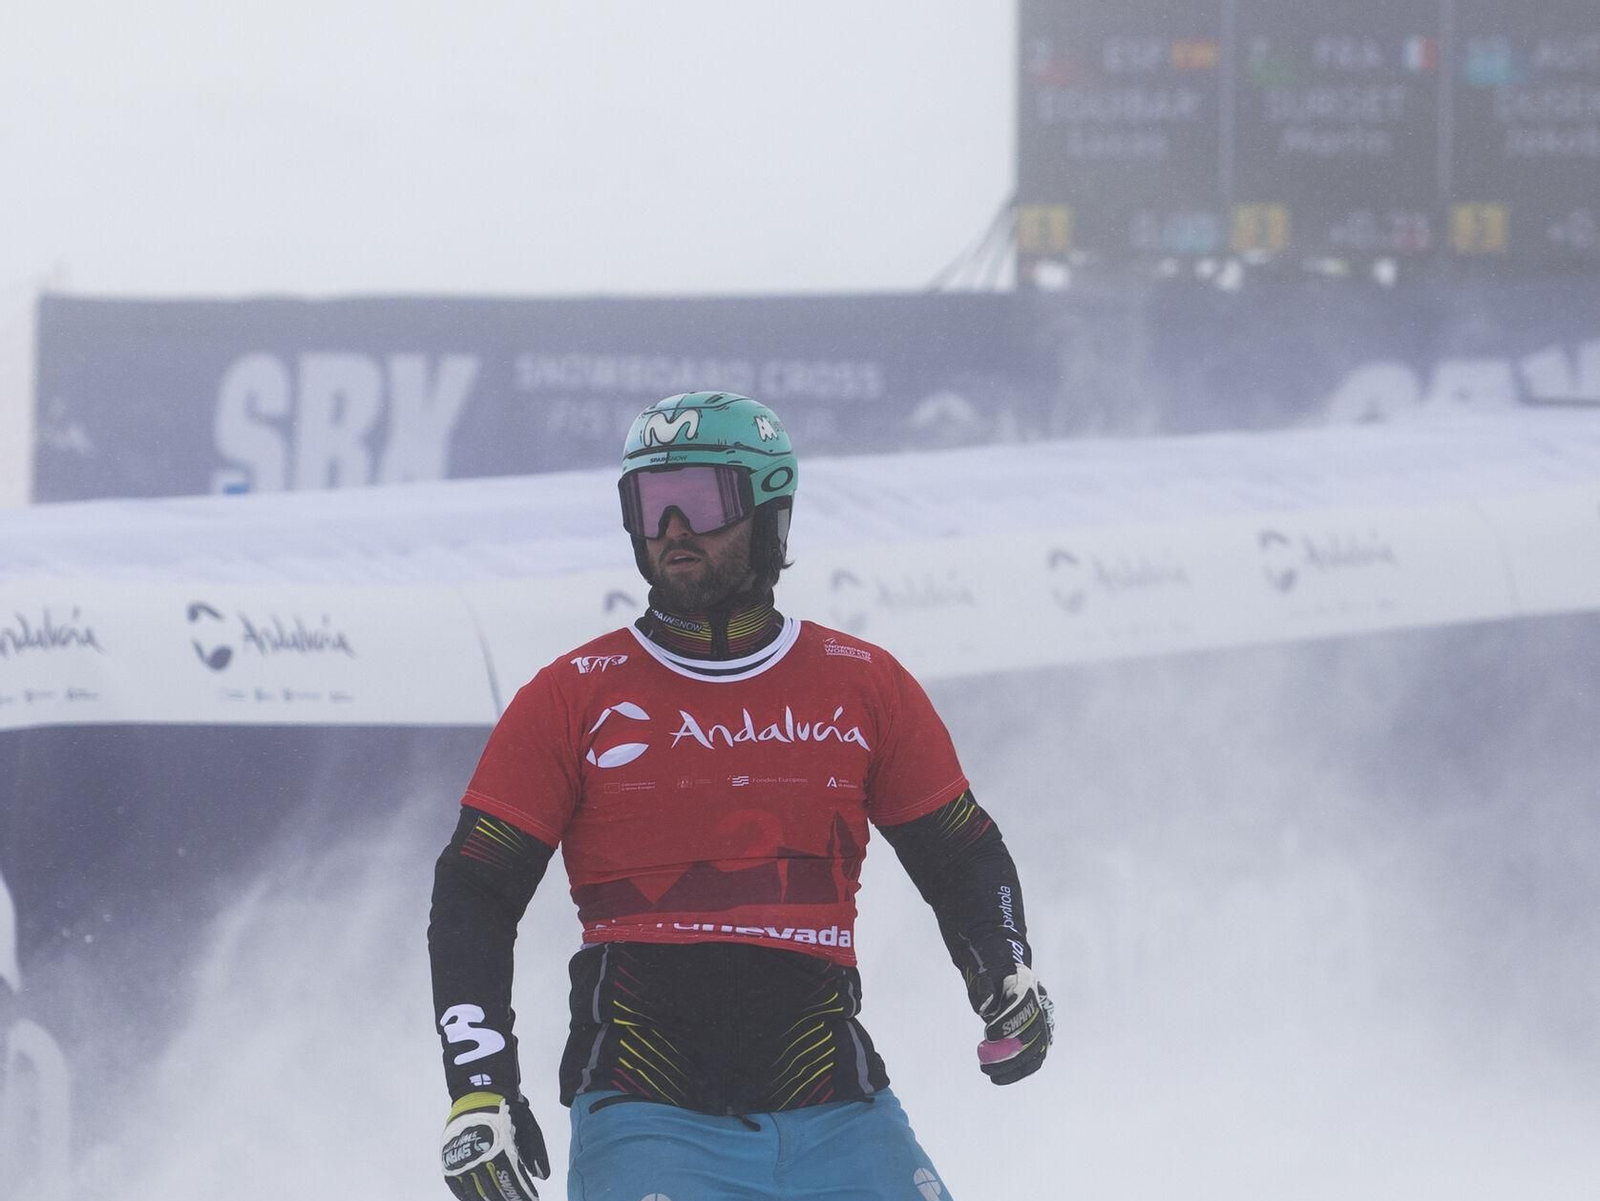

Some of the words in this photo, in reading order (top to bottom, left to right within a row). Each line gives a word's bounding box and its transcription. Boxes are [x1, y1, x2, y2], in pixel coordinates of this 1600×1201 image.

[211, 350, 480, 494] SBX
[669, 704, 872, 752] Andalucía
[1002, 999, 1035, 1036] SWANY
